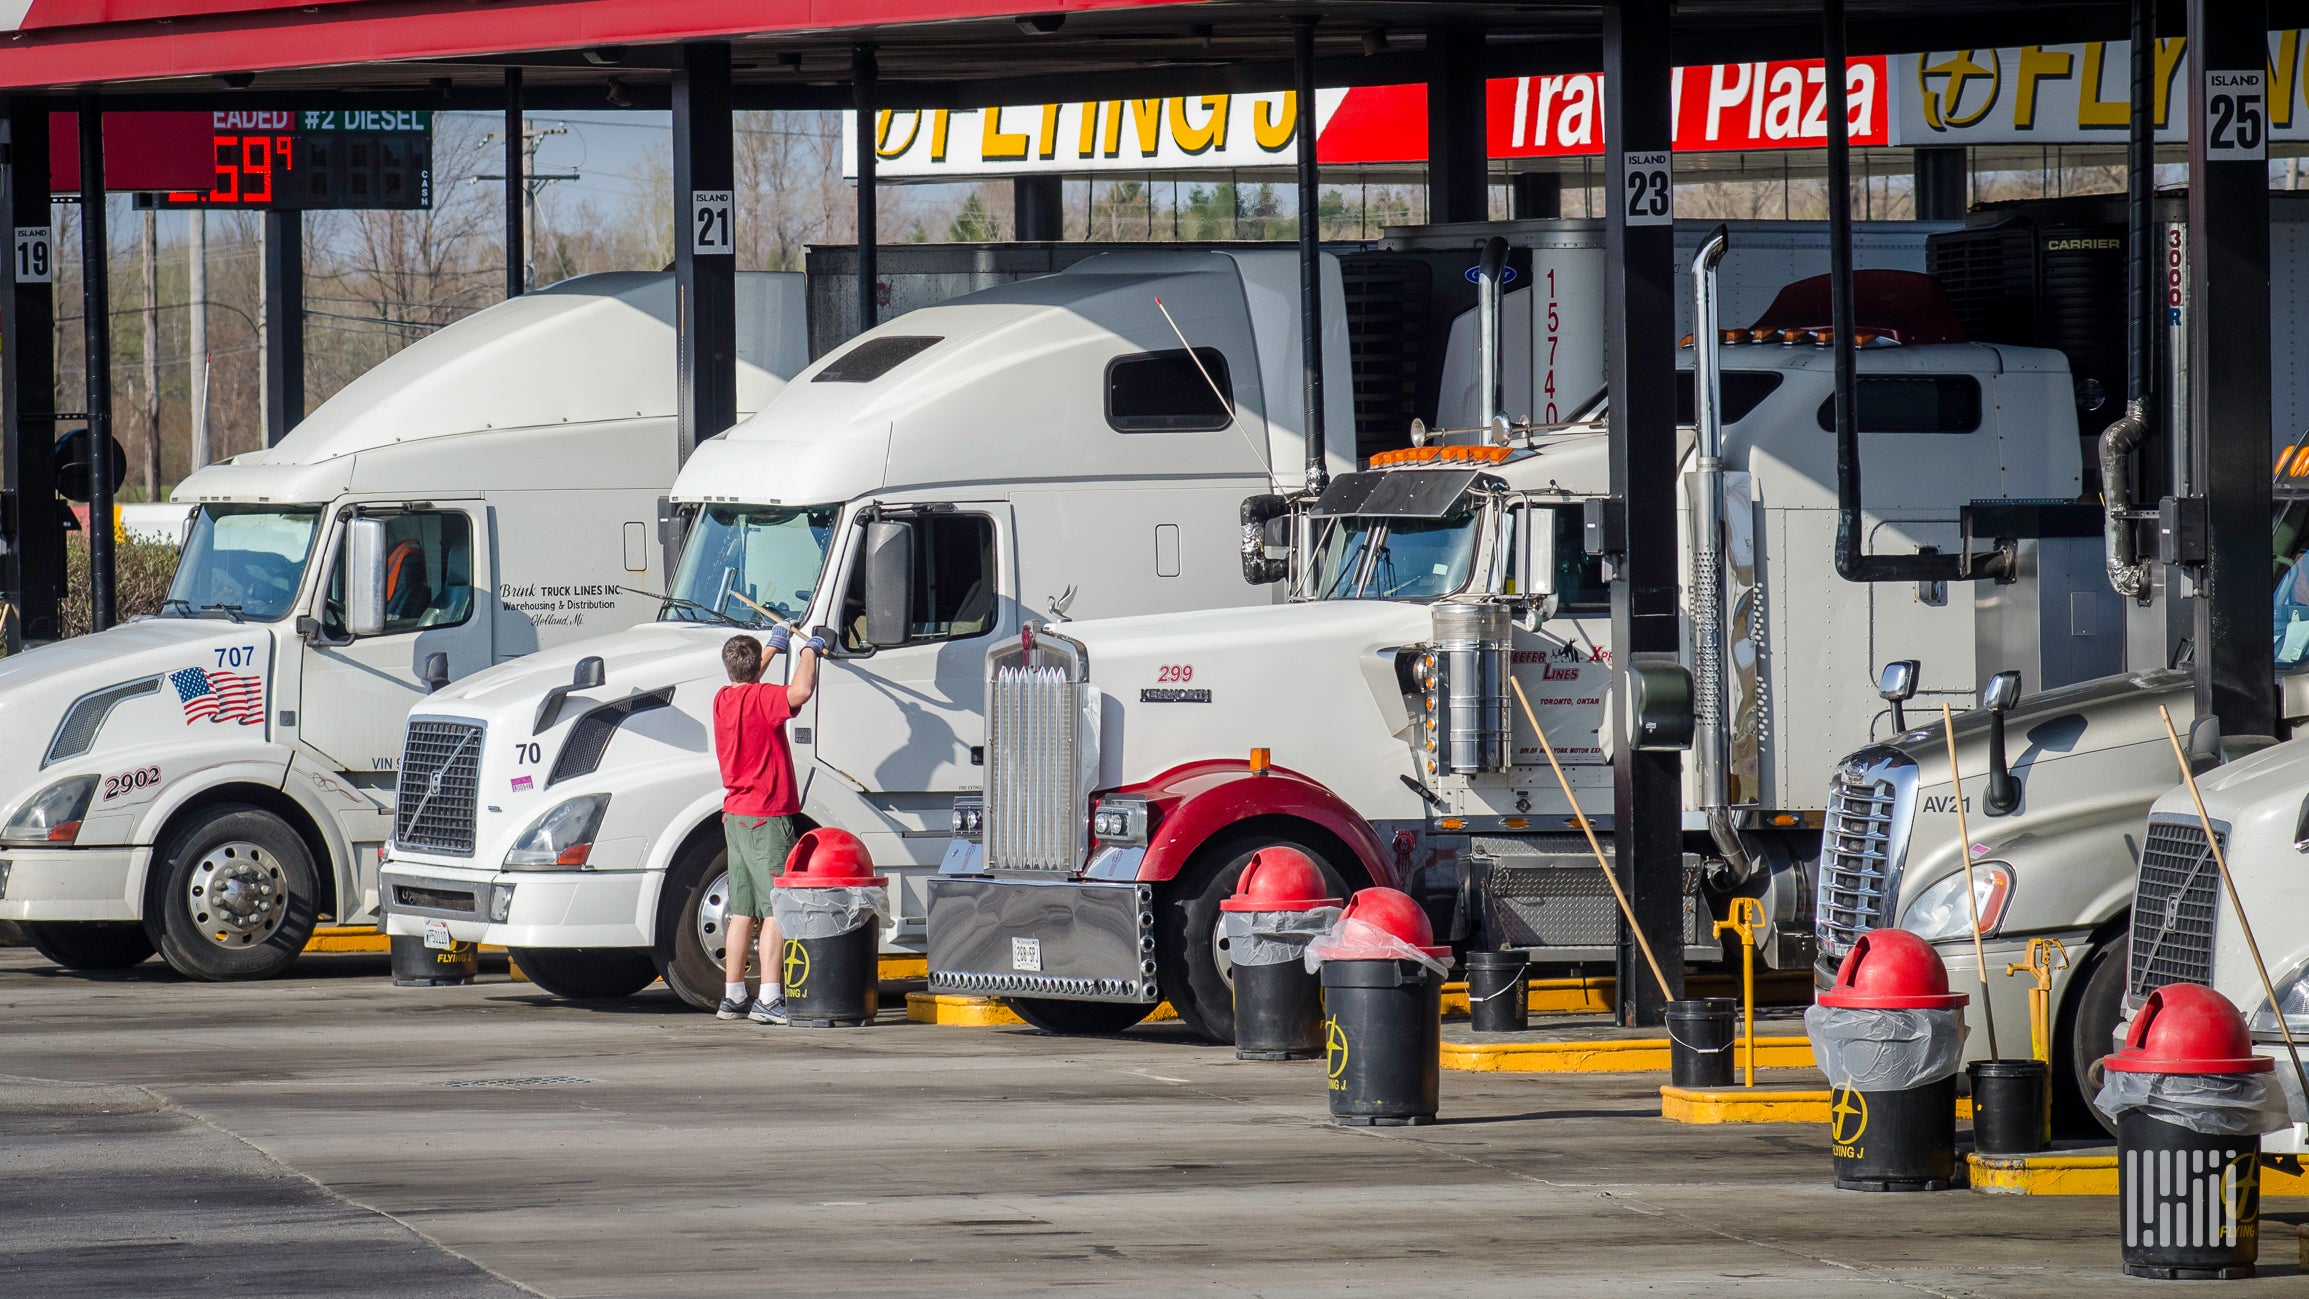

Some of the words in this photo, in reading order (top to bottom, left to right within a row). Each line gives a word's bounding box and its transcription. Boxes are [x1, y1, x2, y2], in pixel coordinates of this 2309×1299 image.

[2211, 75, 2259, 86] ISLAND
[1511, 66, 1684, 147] Tral
[1705, 62, 1875, 141] Plaza
[305, 111, 336, 130] #2
[344, 111, 425, 131] DIESEL
[2210, 94, 2261, 149] 25
[1628, 155, 1667, 165] ISLAND
[421, 170, 429, 206] CASH
[1628, 170, 1669, 217] 23
[696, 194, 729, 202] ISLAND
[697, 207, 729, 246] 21
[2048, 239, 2121, 250] CARRIER
[17, 240, 49, 276] 19
[499, 583, 537, 598] Brink
[541, 586, 571, 597] TRUCK
[574, 585, 603, 596] LINES
[604, 584, 623, 596] INC.
[503, 601, 556, 612] Warehousing
[558, 601, 565, 610] &
[567, 600, 615, 610] Distribution
[214, 645, 255, 669] 707
[1511, 651, 1547, 663] EEFER
[1158, 664, 1194, 682] 299
[1542, 663, 1580, 681] LINES
[1540, 698, 1574, 706] TORONTO,
[515, 742, 541, 765] 70
[372, 757, 393, 770] VIN
[104, 765, 162, 801] 2902
[1922, 796, 1971, 813] AV21
[436, 953, 467, 963] FLYING
[2219, 1224, 2255, 1239] FLYING
